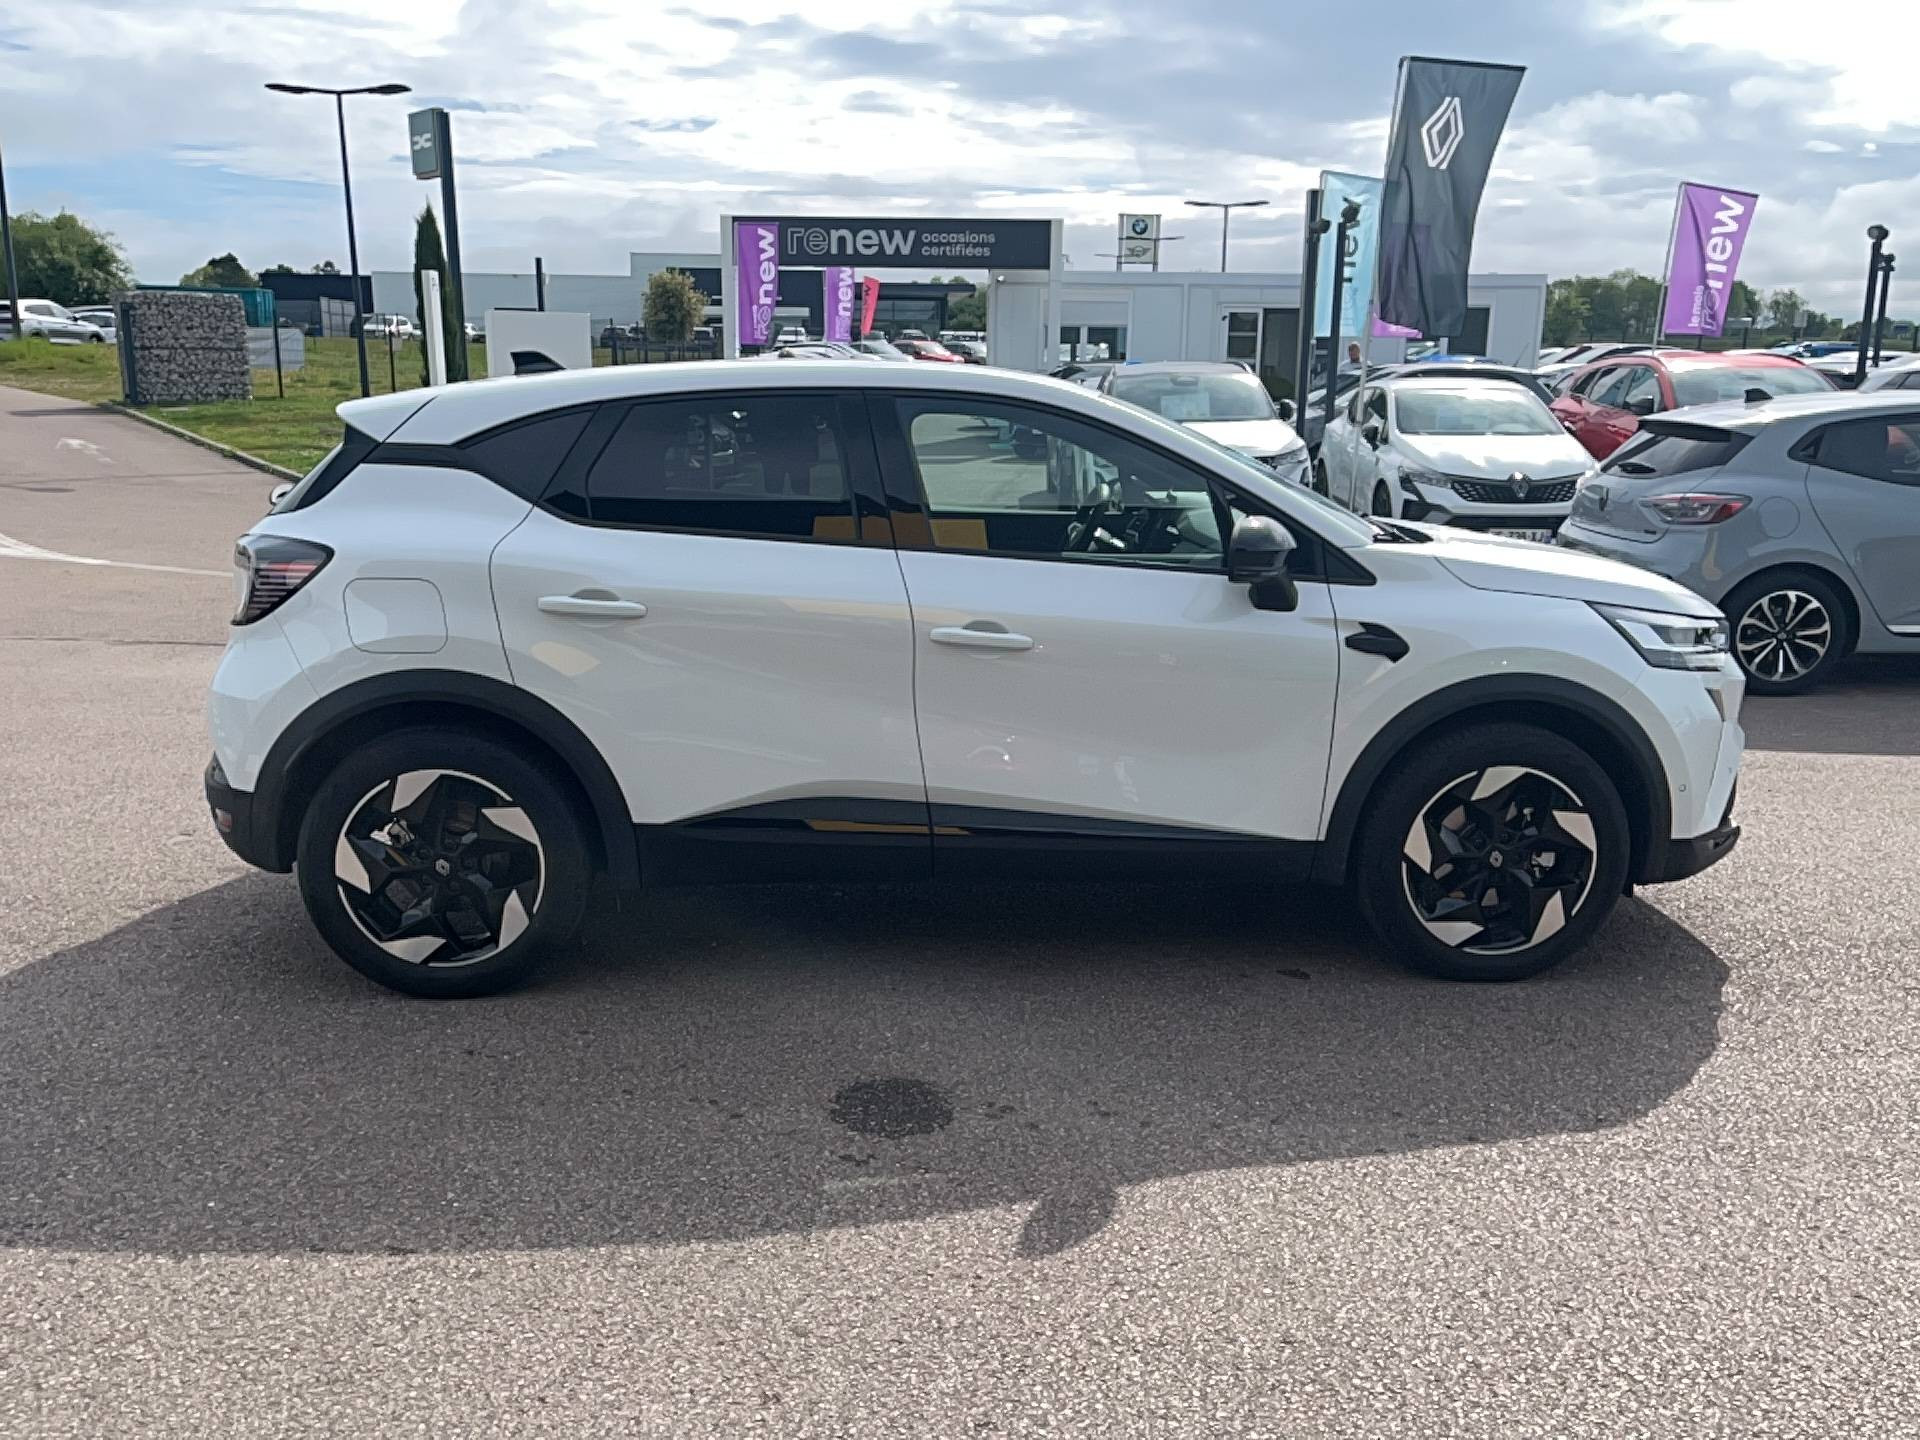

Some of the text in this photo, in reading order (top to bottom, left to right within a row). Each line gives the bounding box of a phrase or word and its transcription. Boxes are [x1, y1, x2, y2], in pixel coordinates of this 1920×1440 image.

[787, 227, 916, 256] renew
[921, 230, 995, 243] occasions
[921, 244, 991, 257] certifiées
[756, 227, 776, 340] renew
